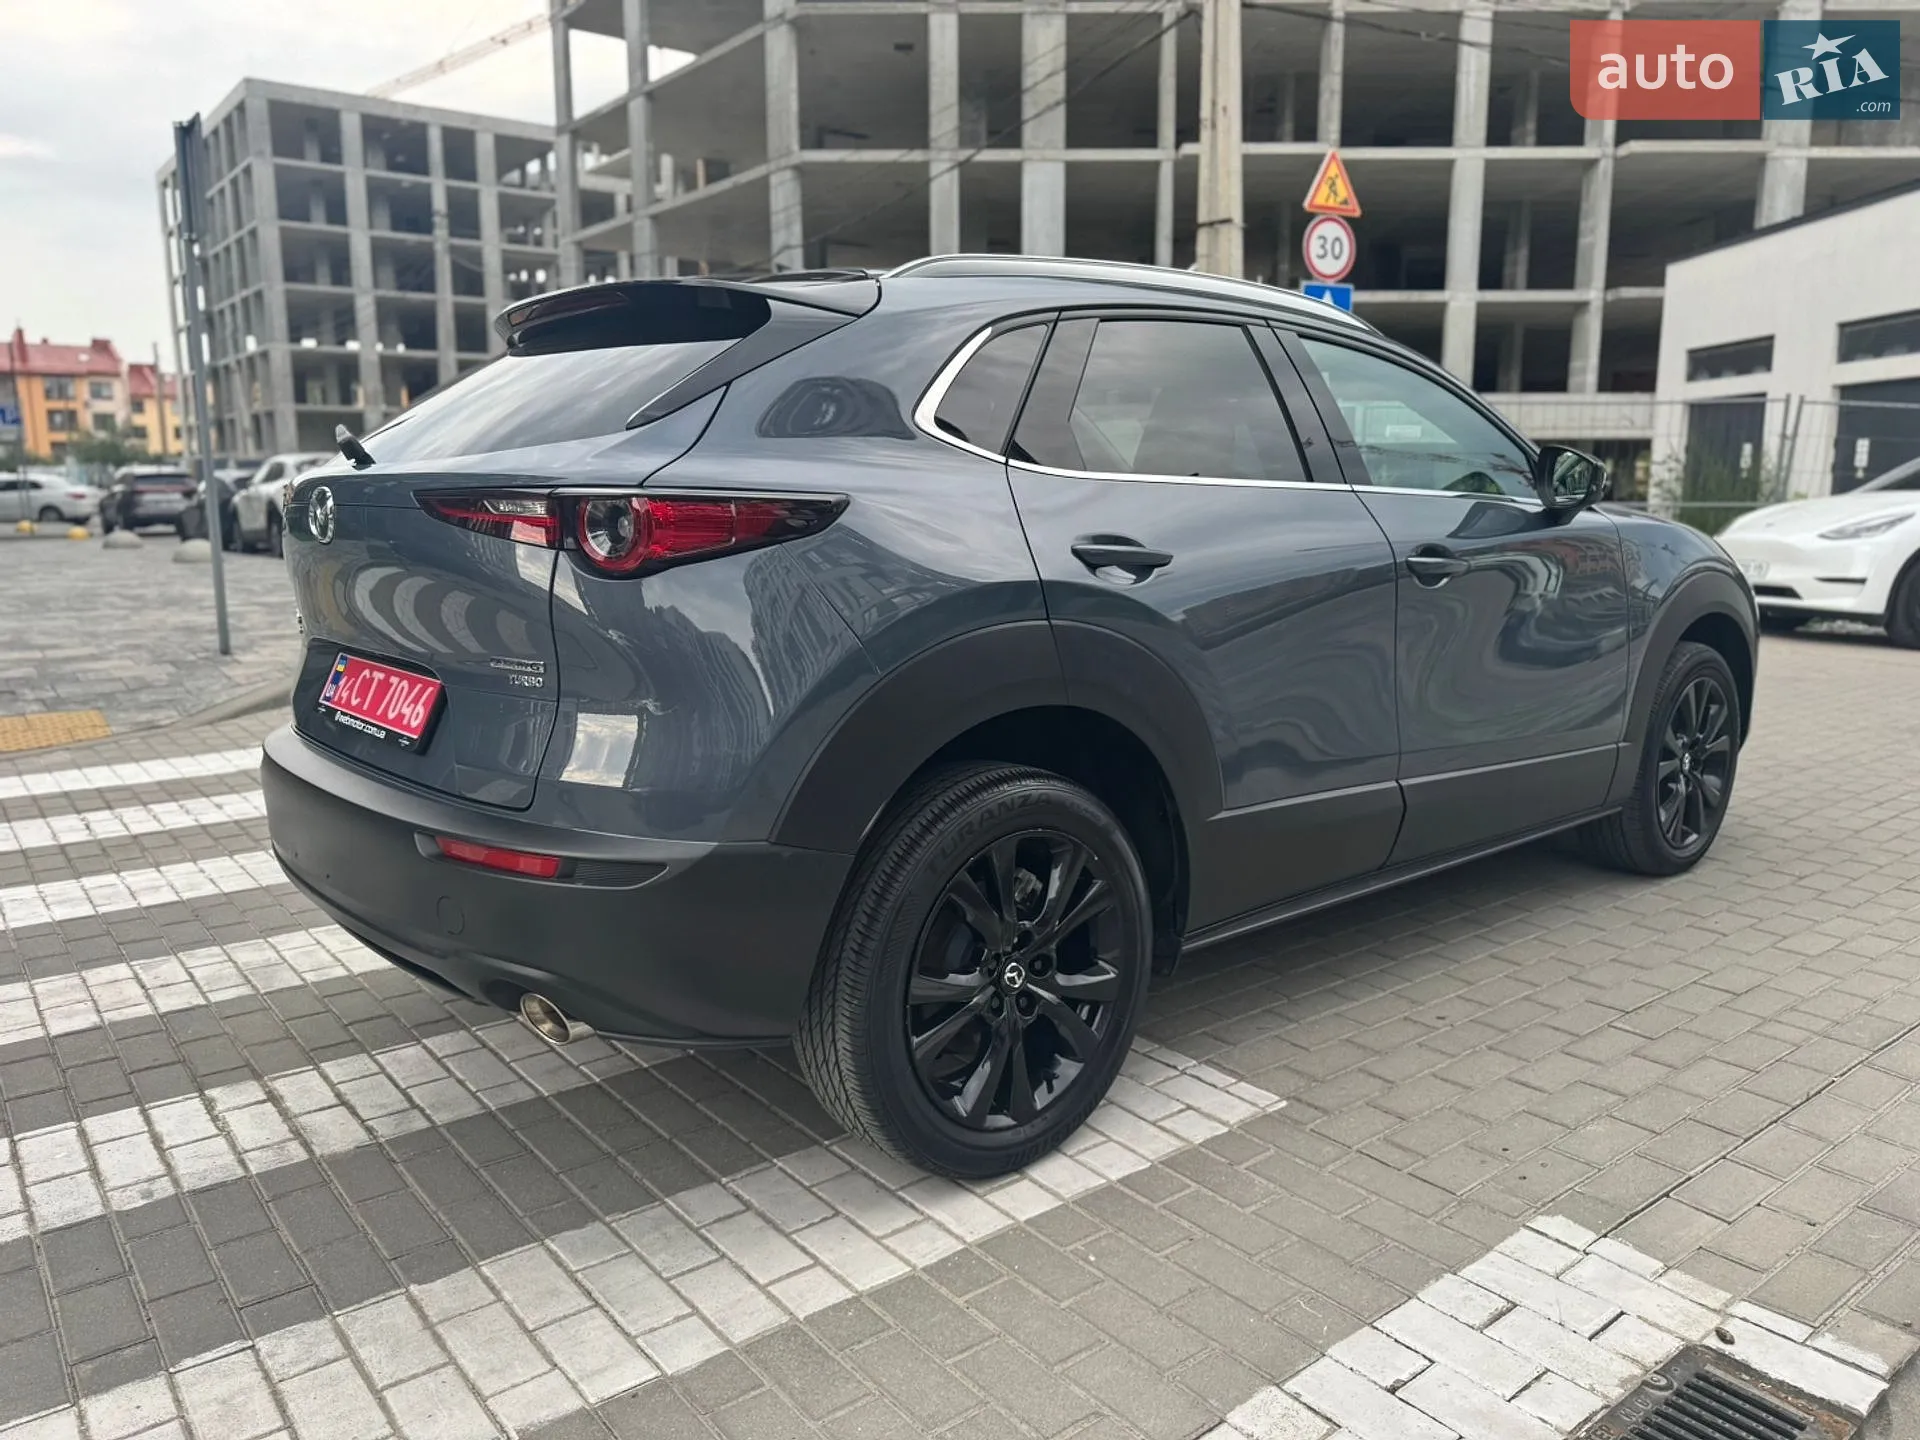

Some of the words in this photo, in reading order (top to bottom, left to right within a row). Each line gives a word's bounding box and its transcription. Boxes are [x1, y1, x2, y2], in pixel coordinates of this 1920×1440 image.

[1316, 235, 1343, 260] 30
[510, 674, 543, 687] TURBO
[376, 676, 434, 728] 7046
[924, 792, 1053, 876] TURANZA
